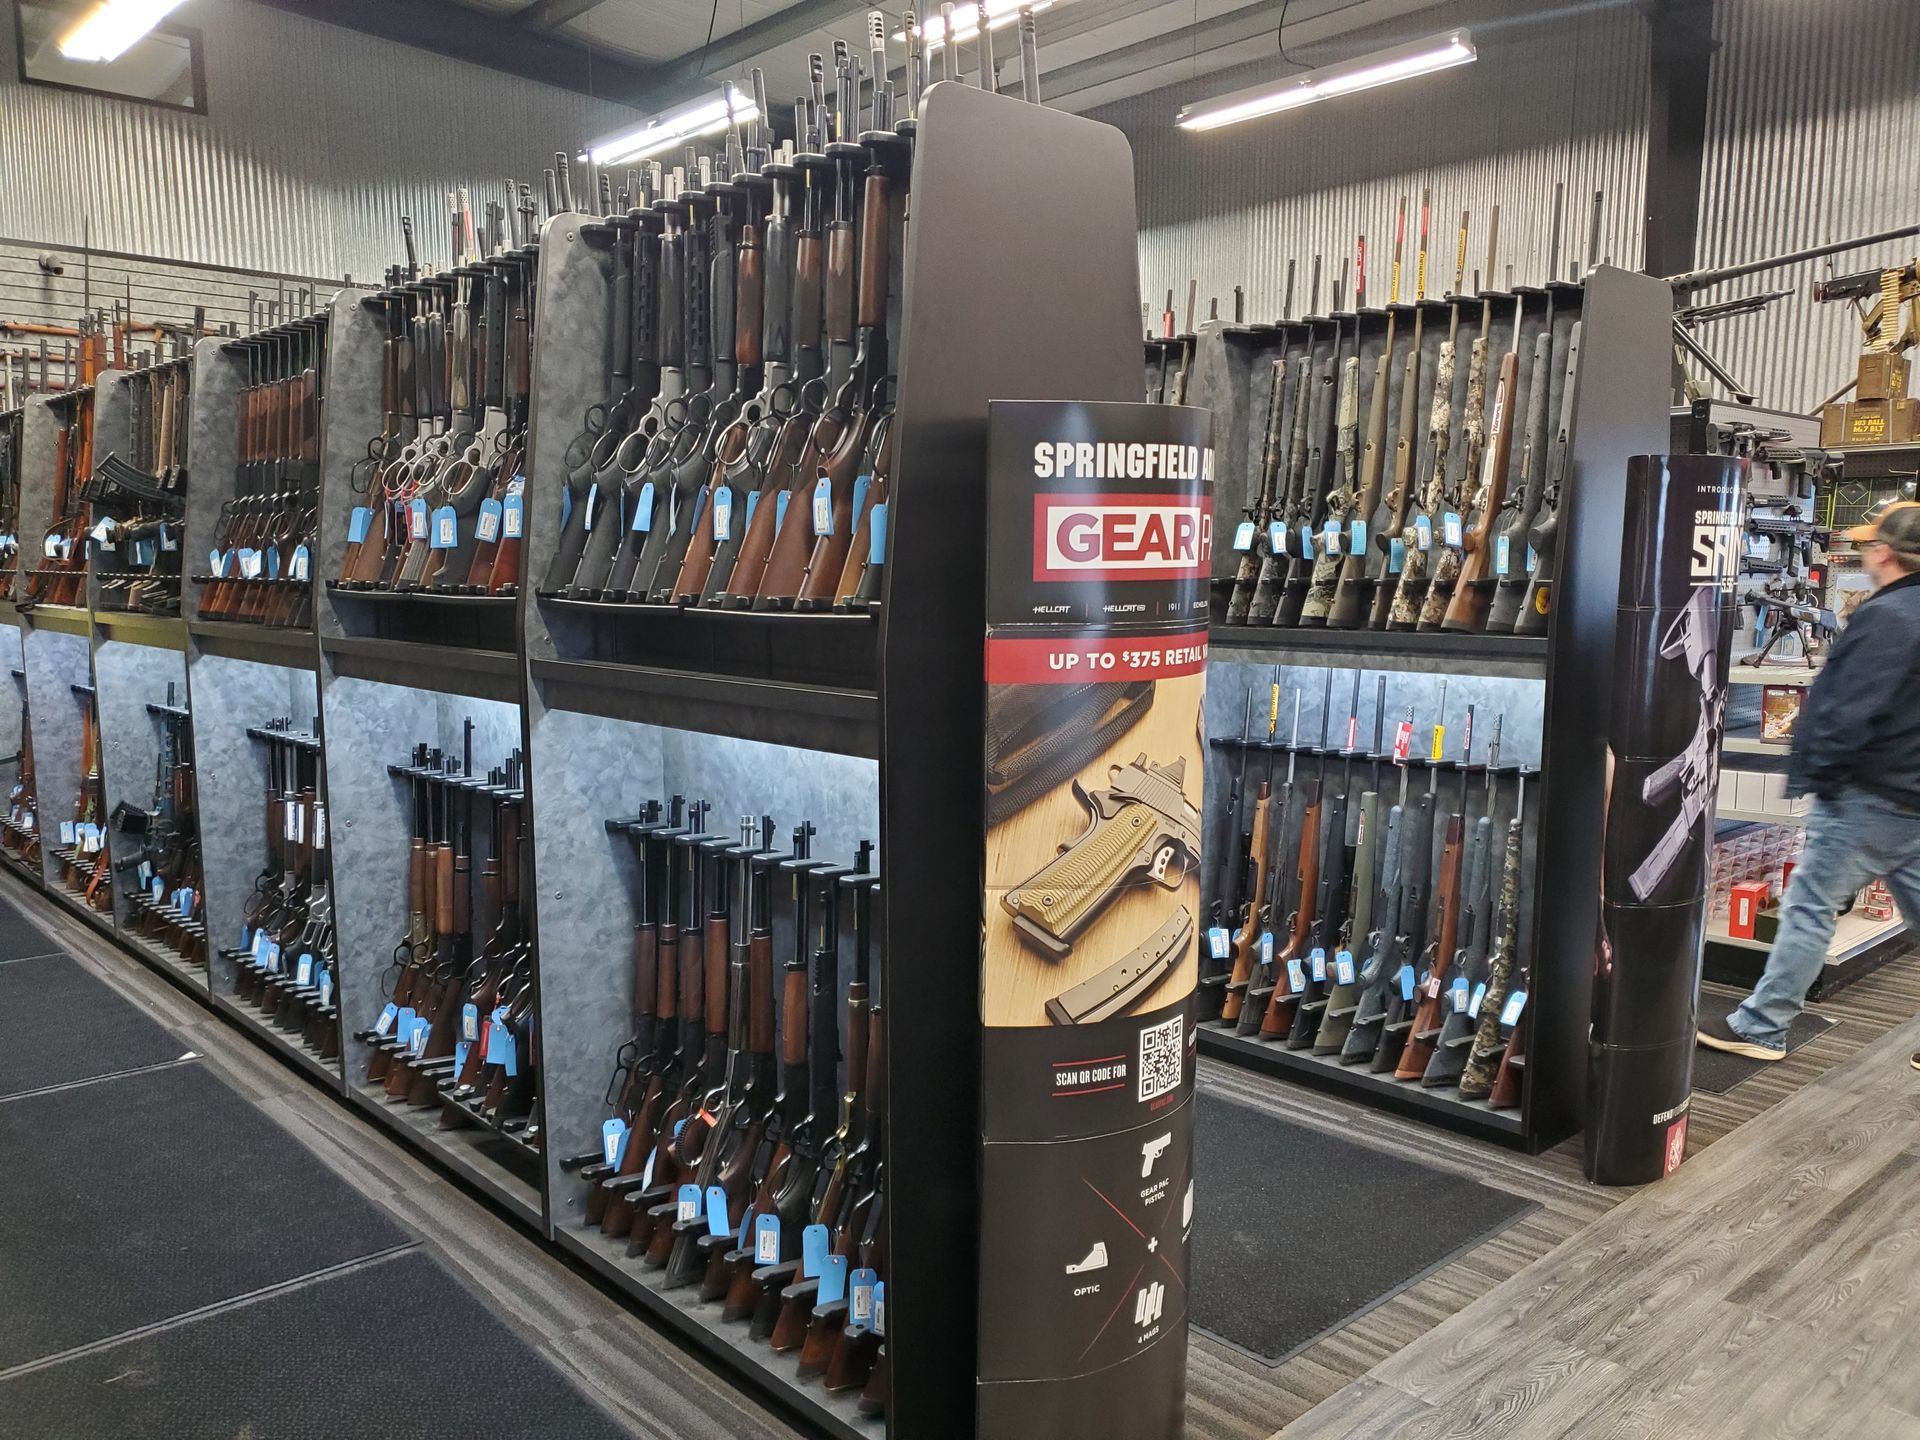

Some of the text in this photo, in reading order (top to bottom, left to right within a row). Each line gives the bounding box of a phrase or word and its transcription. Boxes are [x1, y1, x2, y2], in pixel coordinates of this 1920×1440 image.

[1034, 442, 1215, 481] SPRINGFIELD AR
[1056, 513, 1196, 562] GEAR
[1032, 605, 1071, 614] HELLCAT
[1103, 604, 1137, 613] HELLCAT
[1168, 603, 1181, 611] 1911
[1049, 653, 1079, 670] UP
[1086, 652, 1116, 669] TO
[1122, 650, 1161, 668] $375
[1165, 646, 1202, 666] RETAIL
[1056, 1064, 1127, 1086] SCAN QR CODE FOR
[1140, 1177, 1169, 1198] GEAR PAC
[1144, 1190, 1165, 1206] PISTOL
[1073, 1284, 1100, 1296] OPTIC
[1143, 1325, 1160, 1341] MAGS
